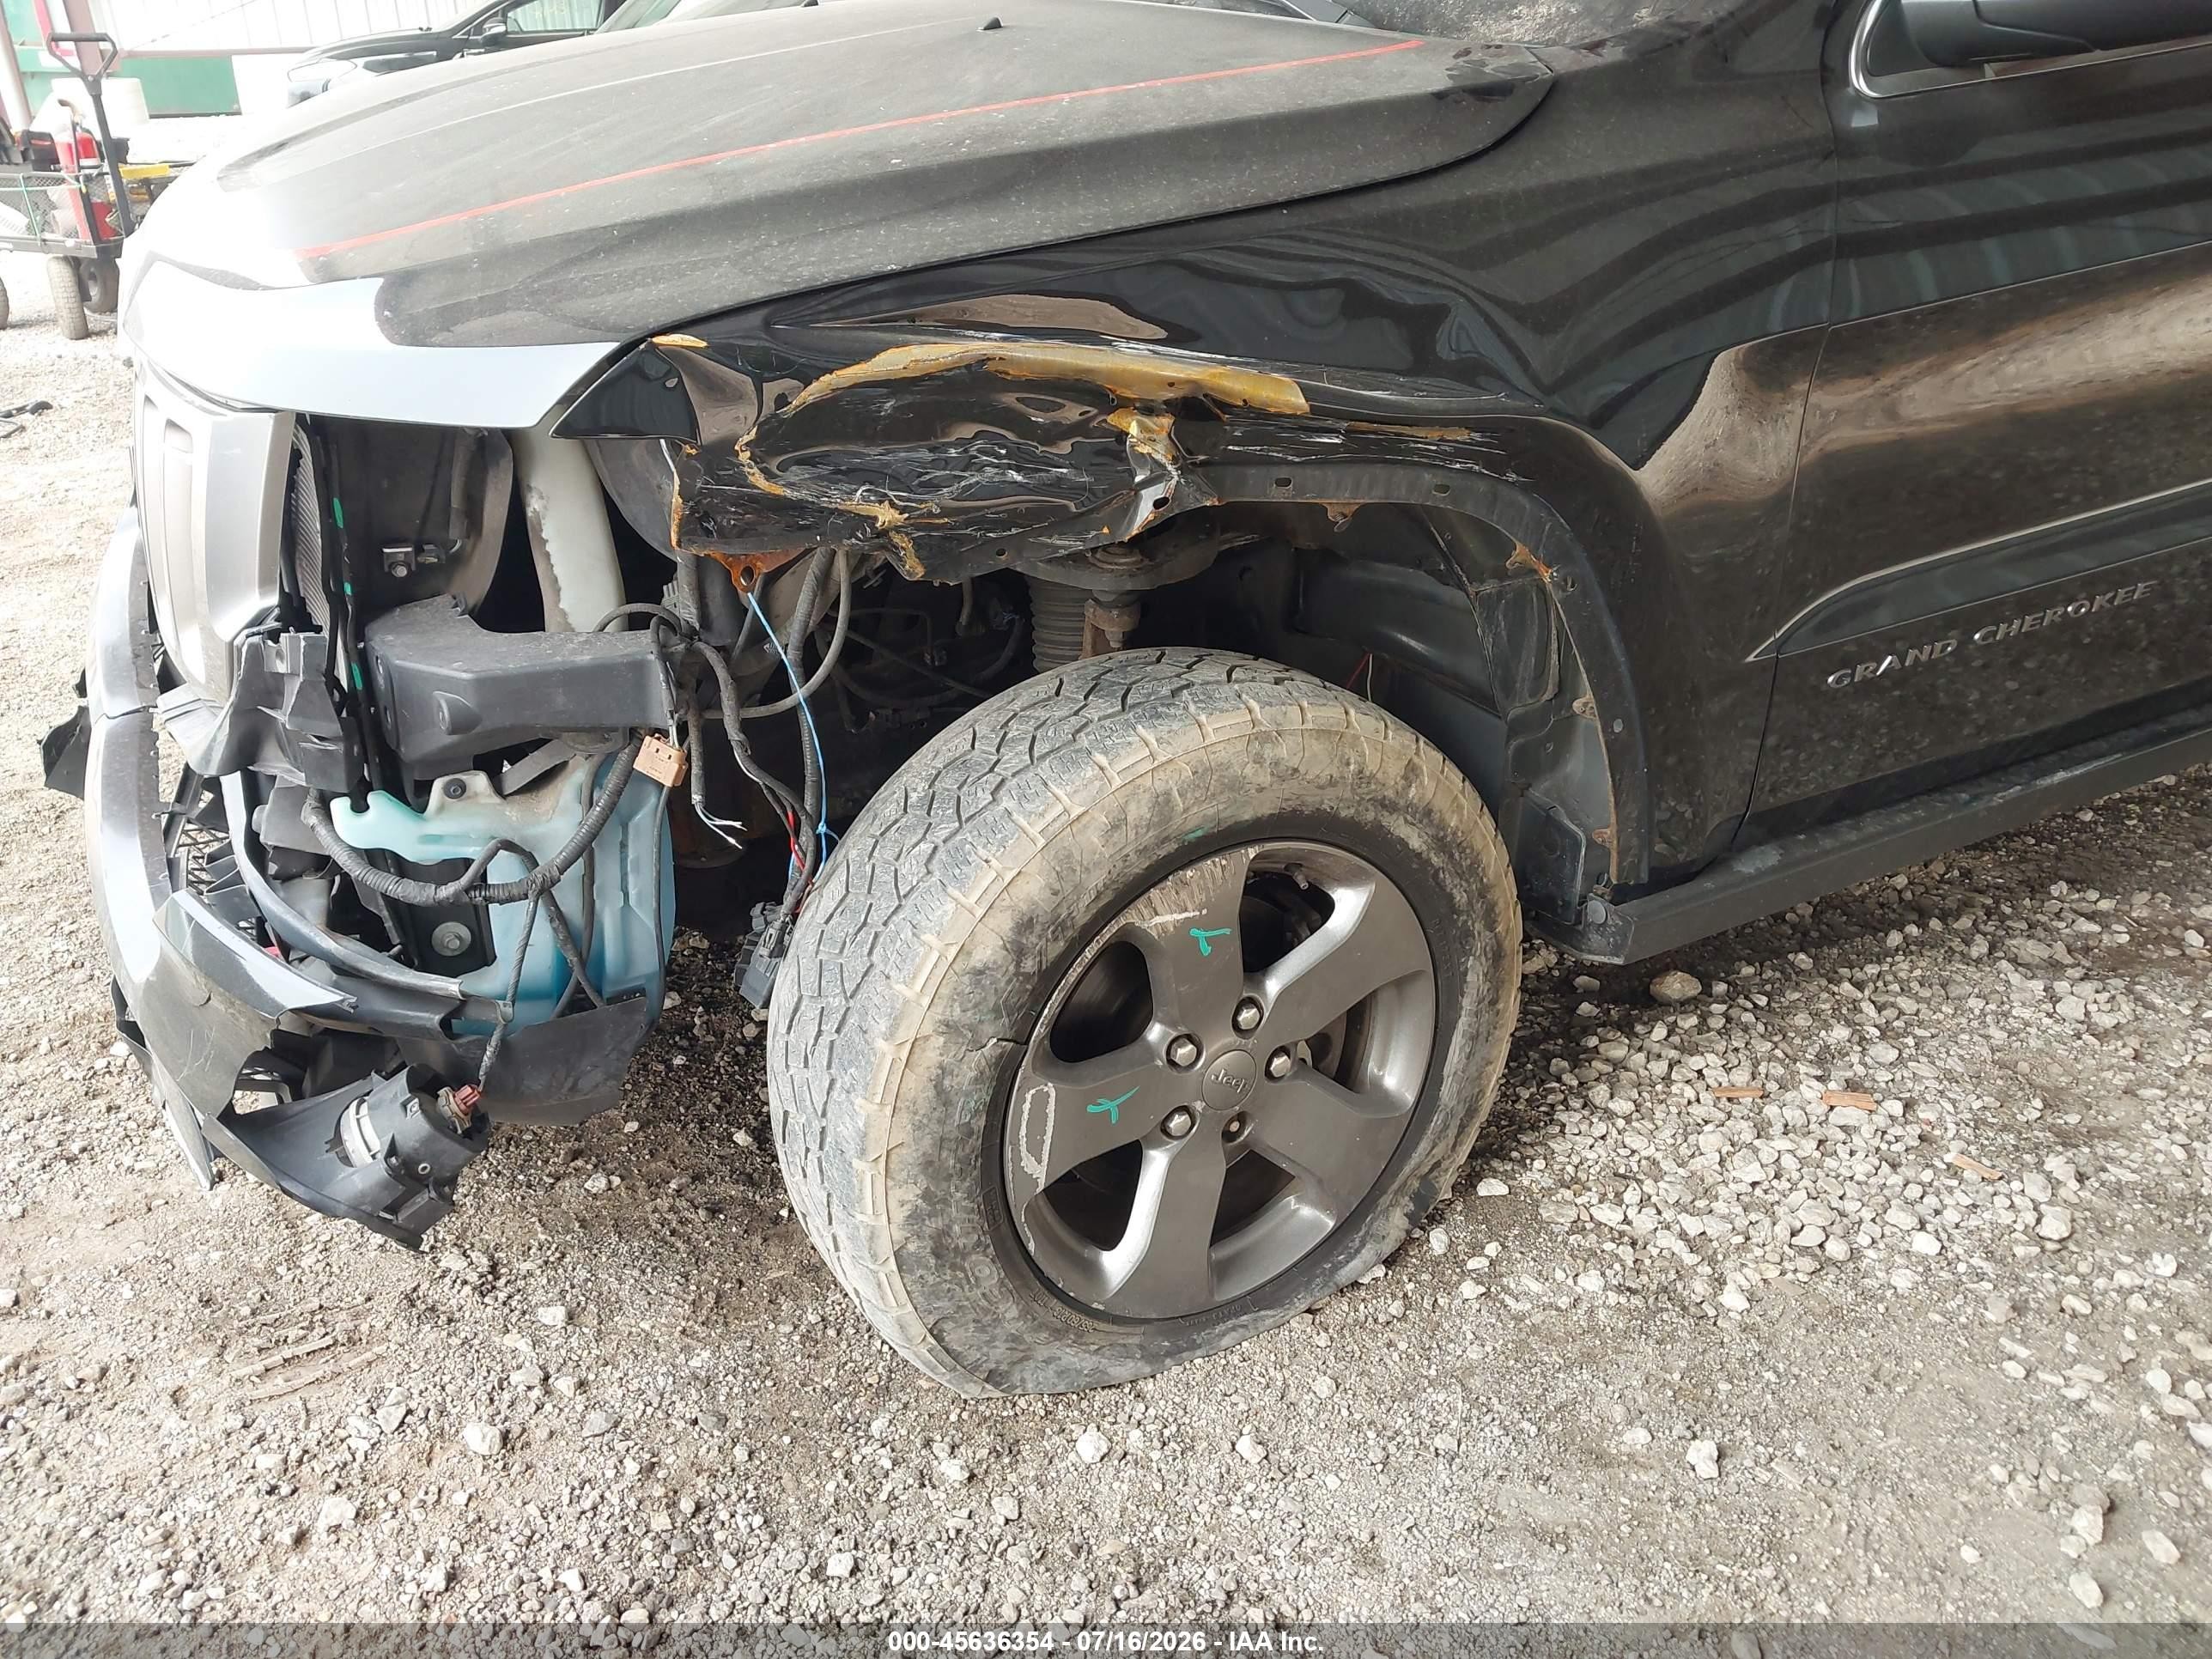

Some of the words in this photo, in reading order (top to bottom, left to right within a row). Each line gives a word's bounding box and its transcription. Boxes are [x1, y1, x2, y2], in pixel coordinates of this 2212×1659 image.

[1826, 639, 1957, 689] GRAND
[1974, 580, 2157, 645] CHEROKEE
[1211, 1068, 1249, 1094] Jeep
